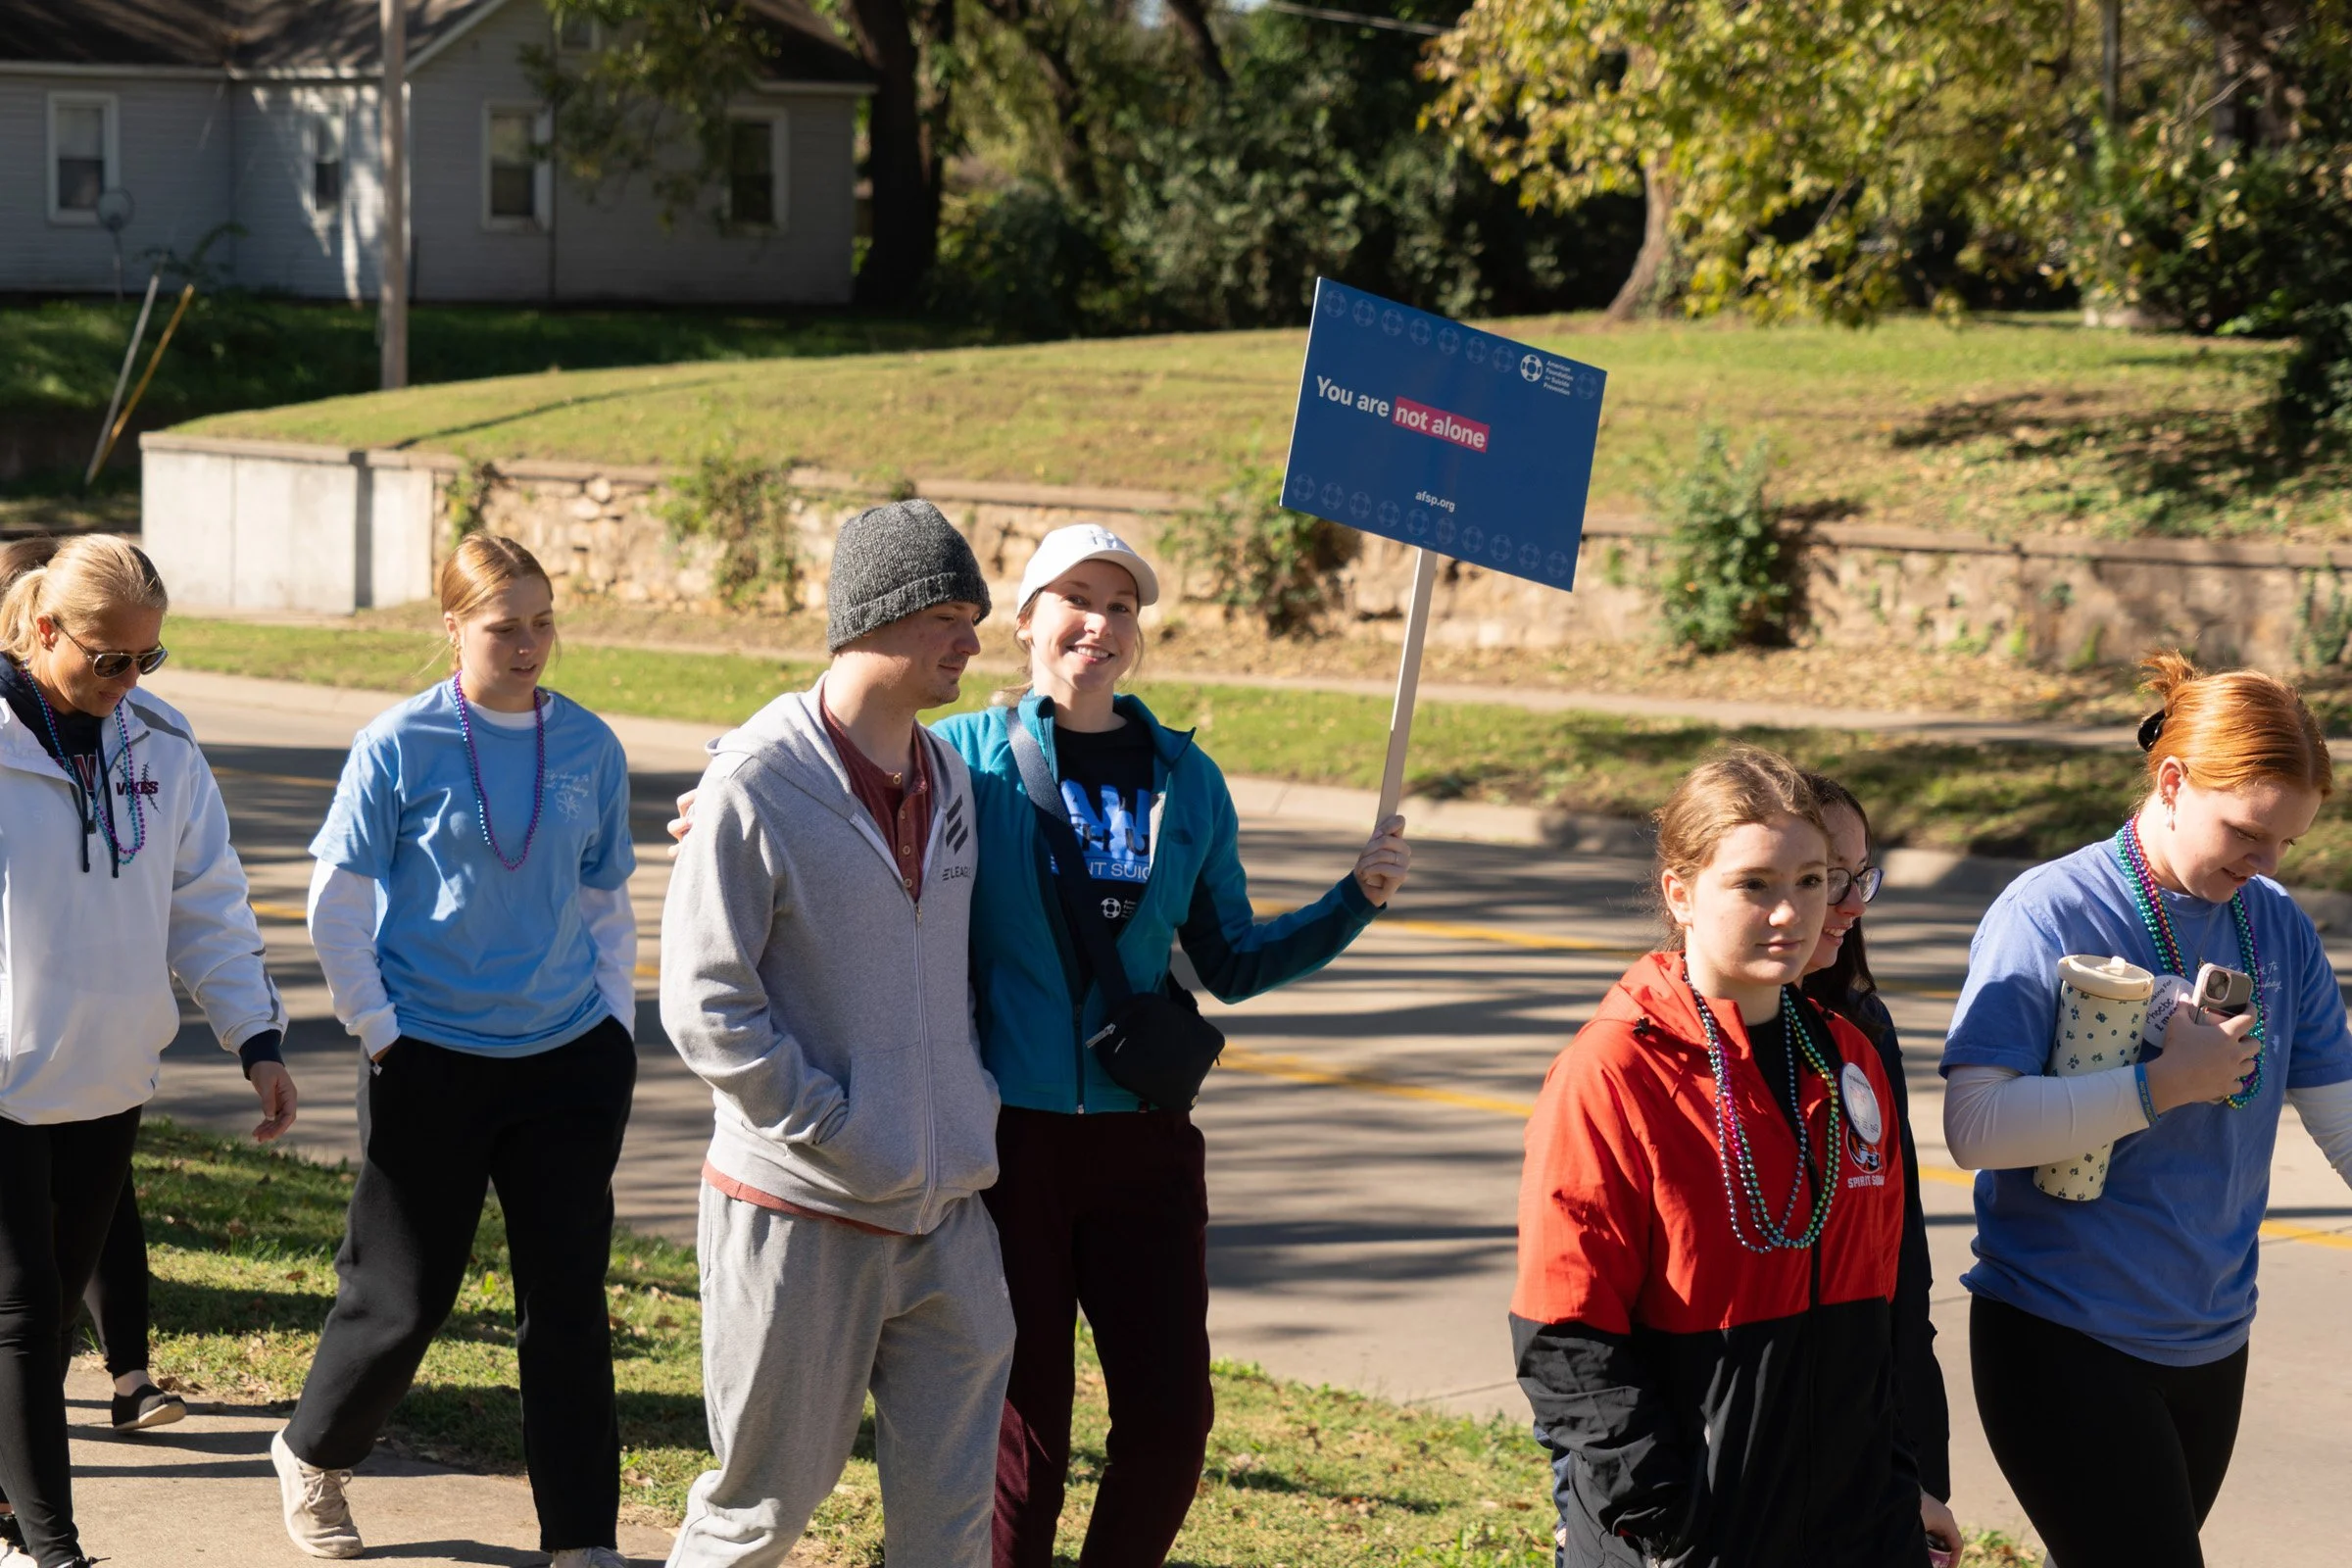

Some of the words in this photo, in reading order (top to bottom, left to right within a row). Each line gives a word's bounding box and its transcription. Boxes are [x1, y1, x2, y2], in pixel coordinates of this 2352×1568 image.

[1546, 361, 1571, 372] American
[1545, 368, 1574, 381] Foundation
[1544, 382, 1570, 396] Prevention
[1551, 377, 1570, 388] Suicide
[1317, 375, 1353, 406] You
[1356, 395, 1390, 417] are
[1395, 406, 1428, 431] not
[1432, 416, 1486, 448] alone
[1415, 491, 1455, 513] afsp.org
[1847, 1175, 1871, 1189] SPIRIT
